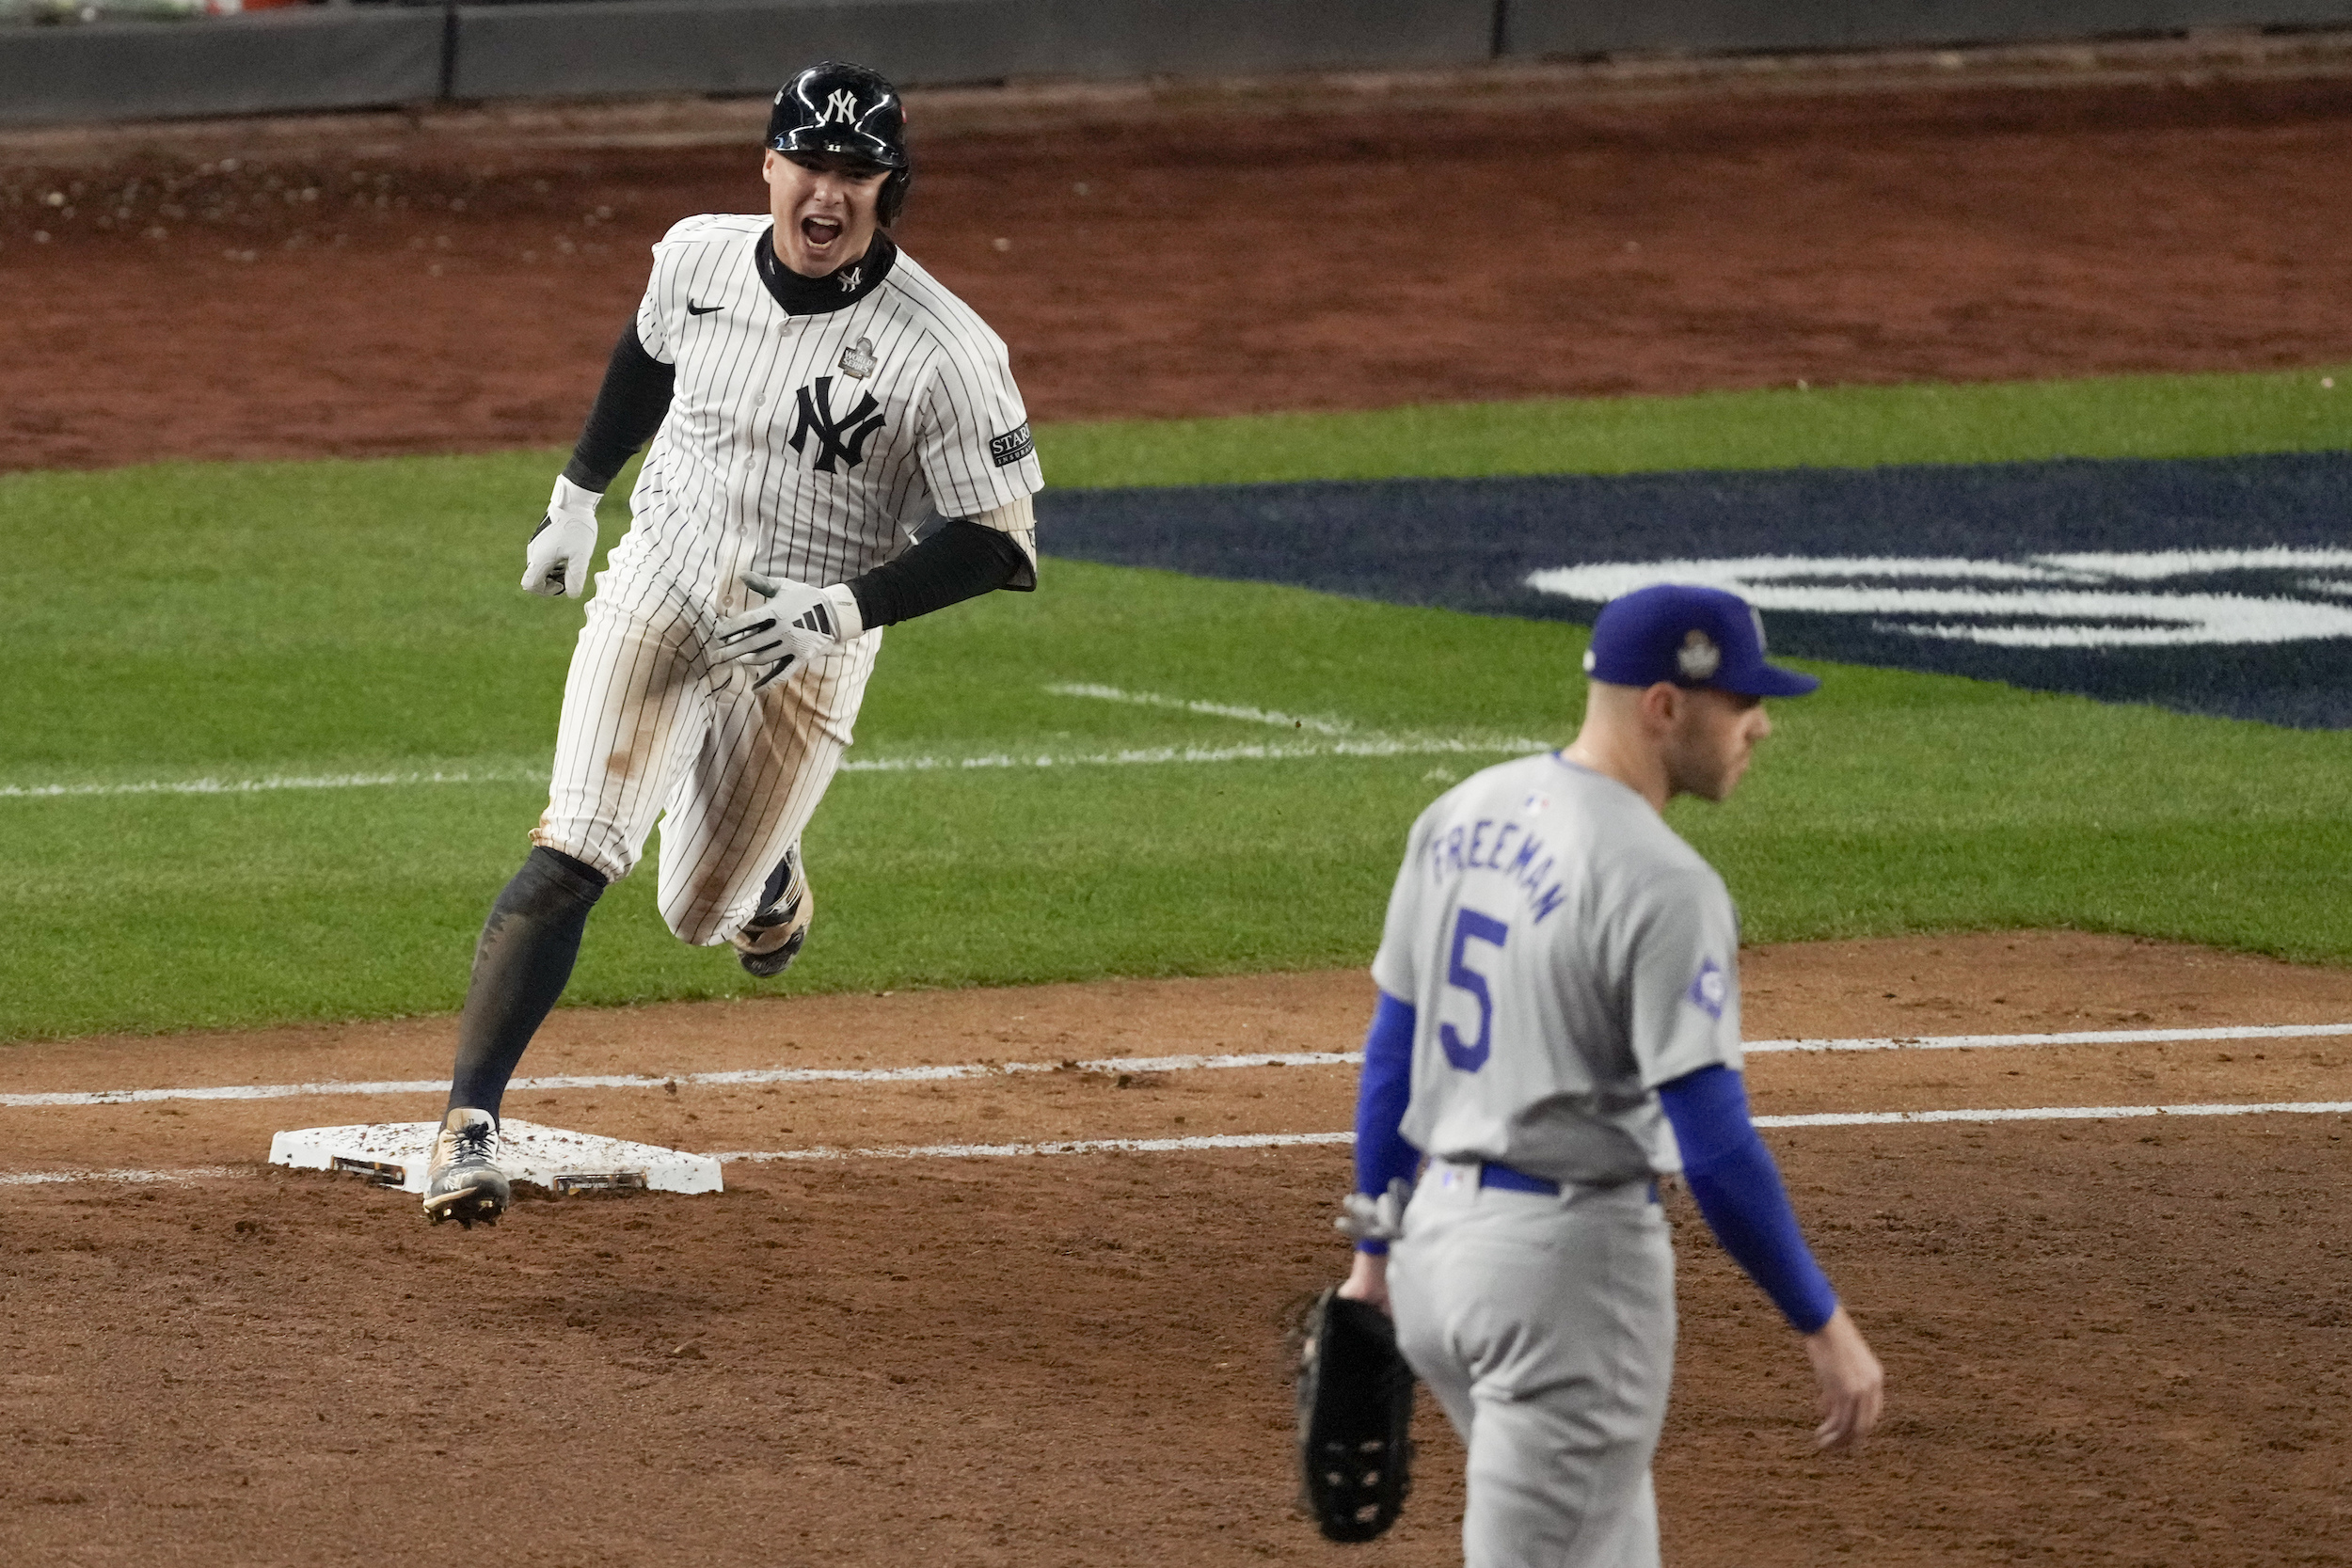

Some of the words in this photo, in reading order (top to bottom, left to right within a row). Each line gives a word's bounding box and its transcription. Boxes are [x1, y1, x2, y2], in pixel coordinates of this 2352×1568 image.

[823, 88, 858, 125] NY
[840, 358, 869, 373] SERIES
[844, 350, 874, 366] WORLD
[788, 376, 886, 474] NY
[1432, 819, 1568, 926] FREEMAN
[1439, 908, 1508, 1073] 5
